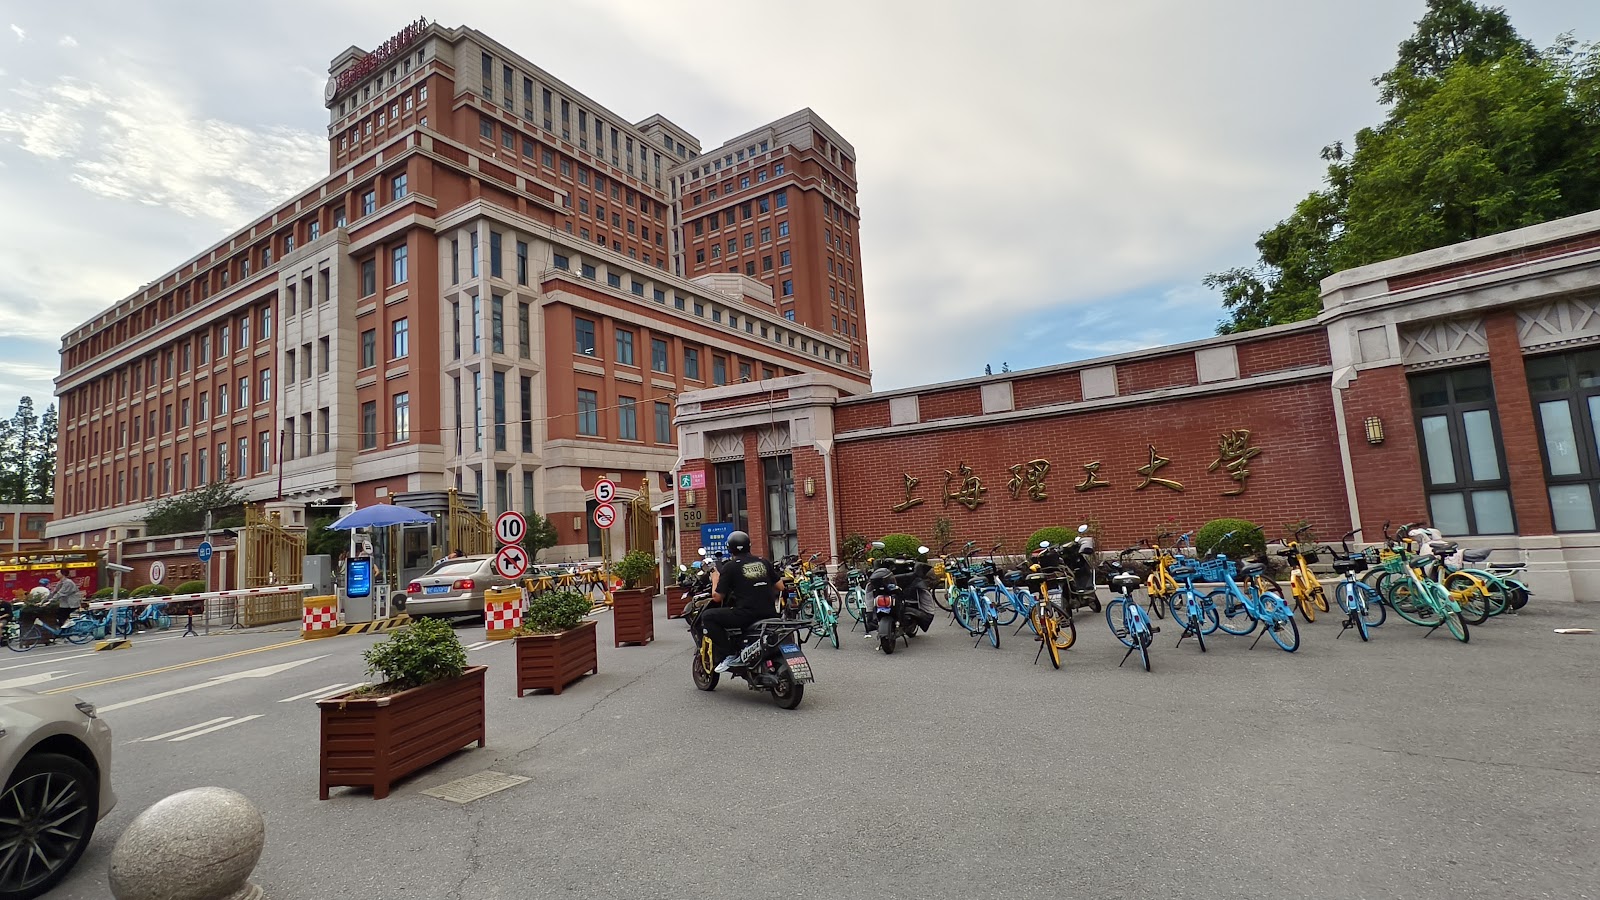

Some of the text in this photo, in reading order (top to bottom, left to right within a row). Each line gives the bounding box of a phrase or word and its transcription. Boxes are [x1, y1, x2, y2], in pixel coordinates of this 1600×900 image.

[600, 485, 610, 498] 5
[684, 511, 702, 521] 580
[502, 519, 521, 537] 10
[199, 548, 211, 556] 出口
